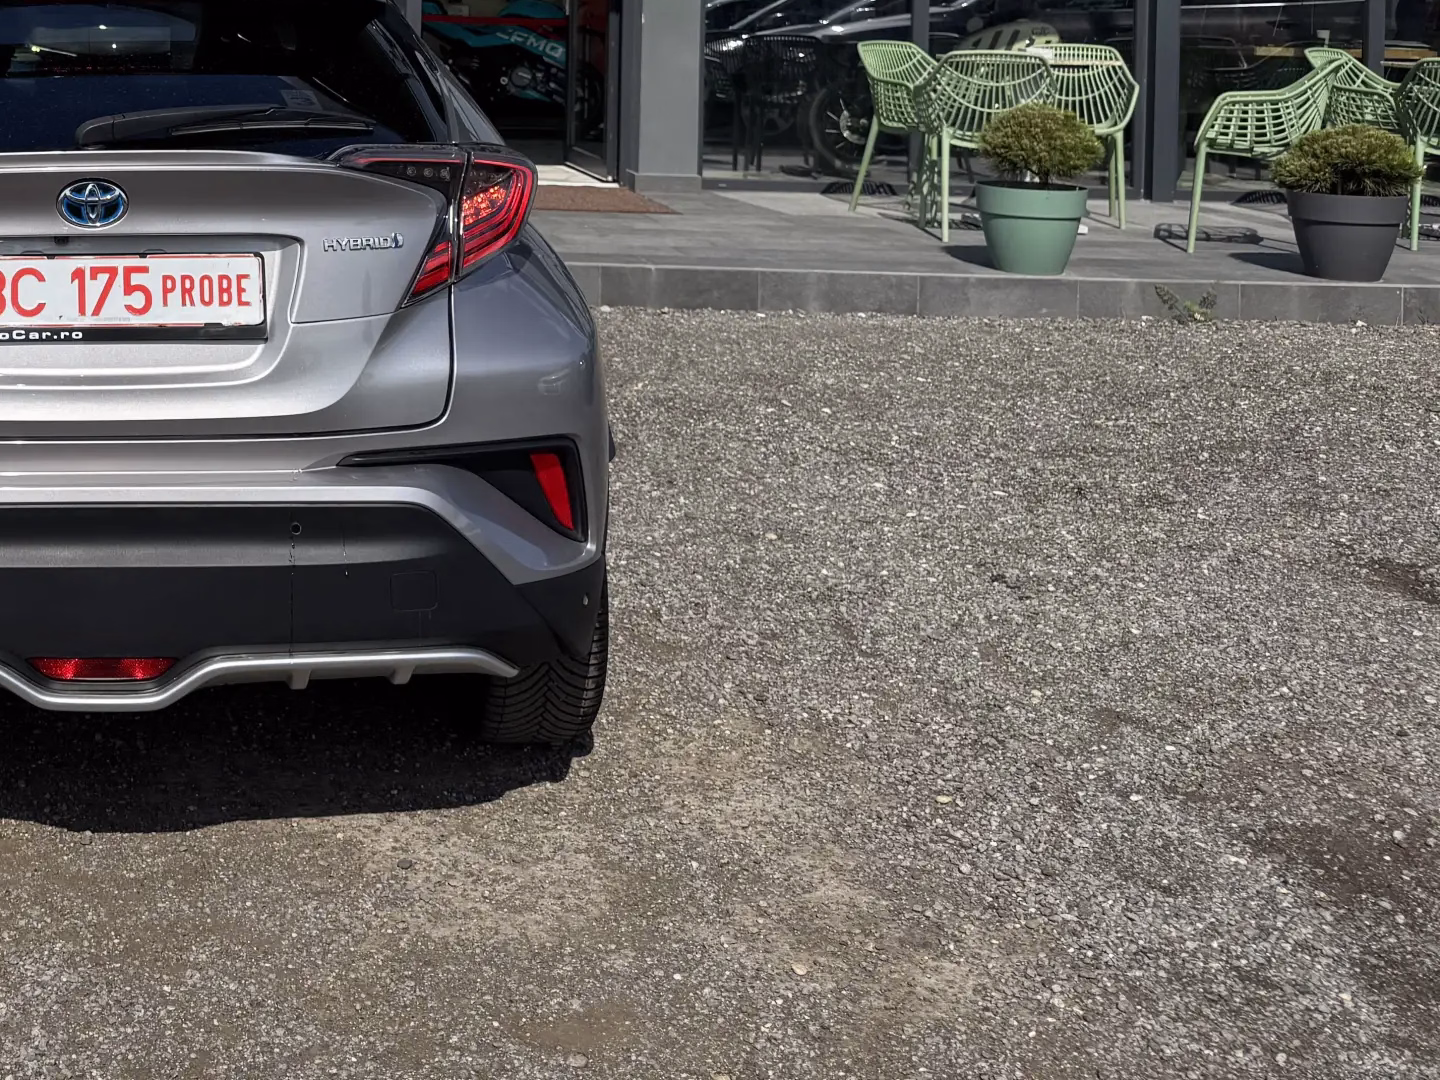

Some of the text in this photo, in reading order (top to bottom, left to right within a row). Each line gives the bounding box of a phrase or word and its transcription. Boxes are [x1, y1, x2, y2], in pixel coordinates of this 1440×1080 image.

[323, 236, 392, 252] HYBRID
[70, 265, 153, 317] 175
[161, 274, 253, 307] PROBE
